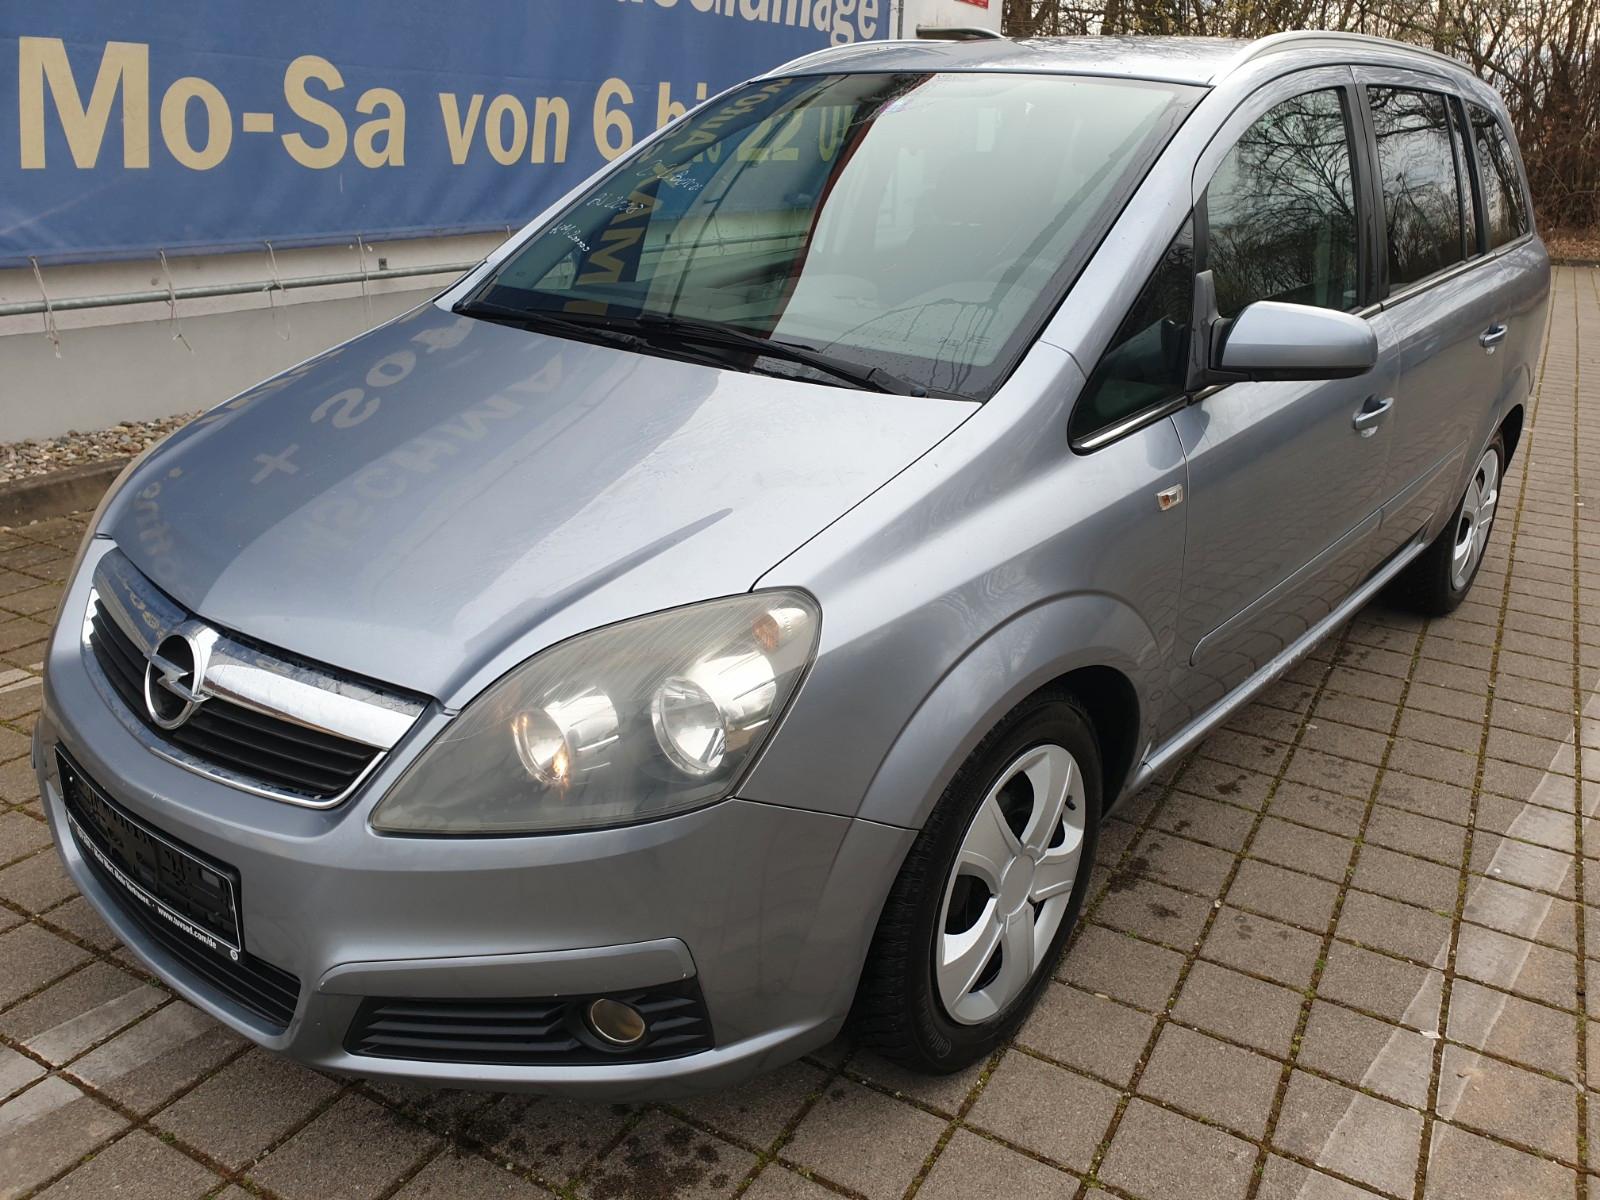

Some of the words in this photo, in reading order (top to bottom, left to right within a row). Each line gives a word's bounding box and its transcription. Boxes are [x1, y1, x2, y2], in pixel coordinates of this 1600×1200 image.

[18, 36, 406, 170] Mo-Sa
[438, 92, 570, 166] von
[593, 77, 634, 162] 6
